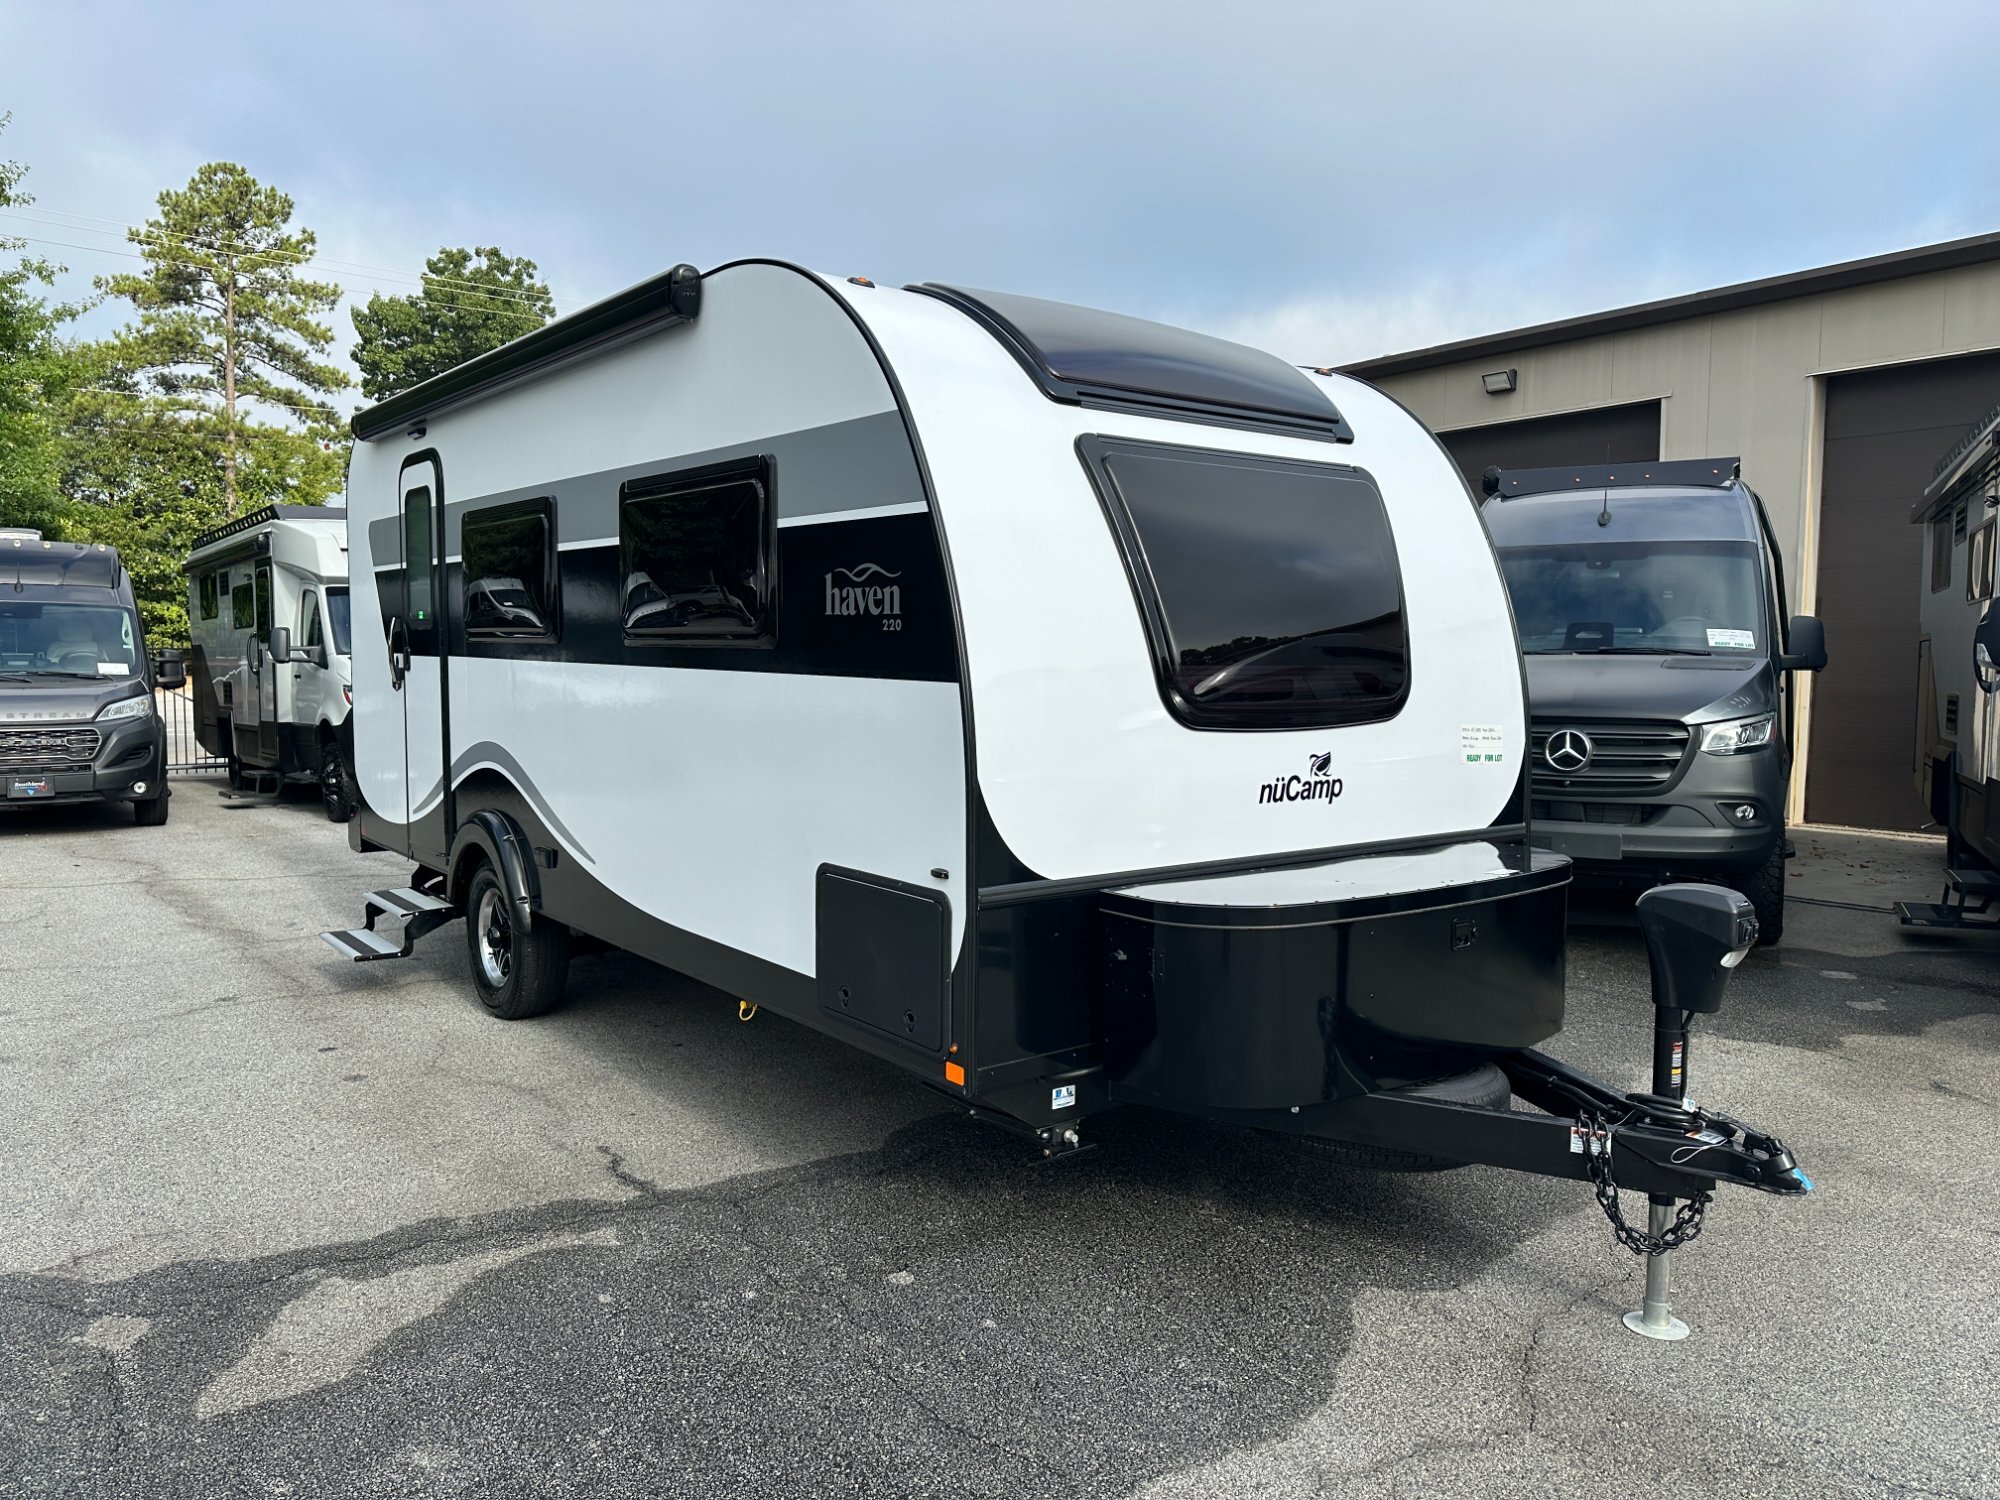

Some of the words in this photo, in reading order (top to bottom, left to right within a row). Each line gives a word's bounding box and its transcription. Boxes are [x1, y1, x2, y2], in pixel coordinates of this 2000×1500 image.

[824, 572, 902, 616] haven
[882, 618, 902, 631] 220
[1466, 754, 1481, 762] READY
[1484, 754, 1494, 762] FOR
[1494, 754, 1503, 762] LOT
[1258, 774, 1343, 805] nüCamp
